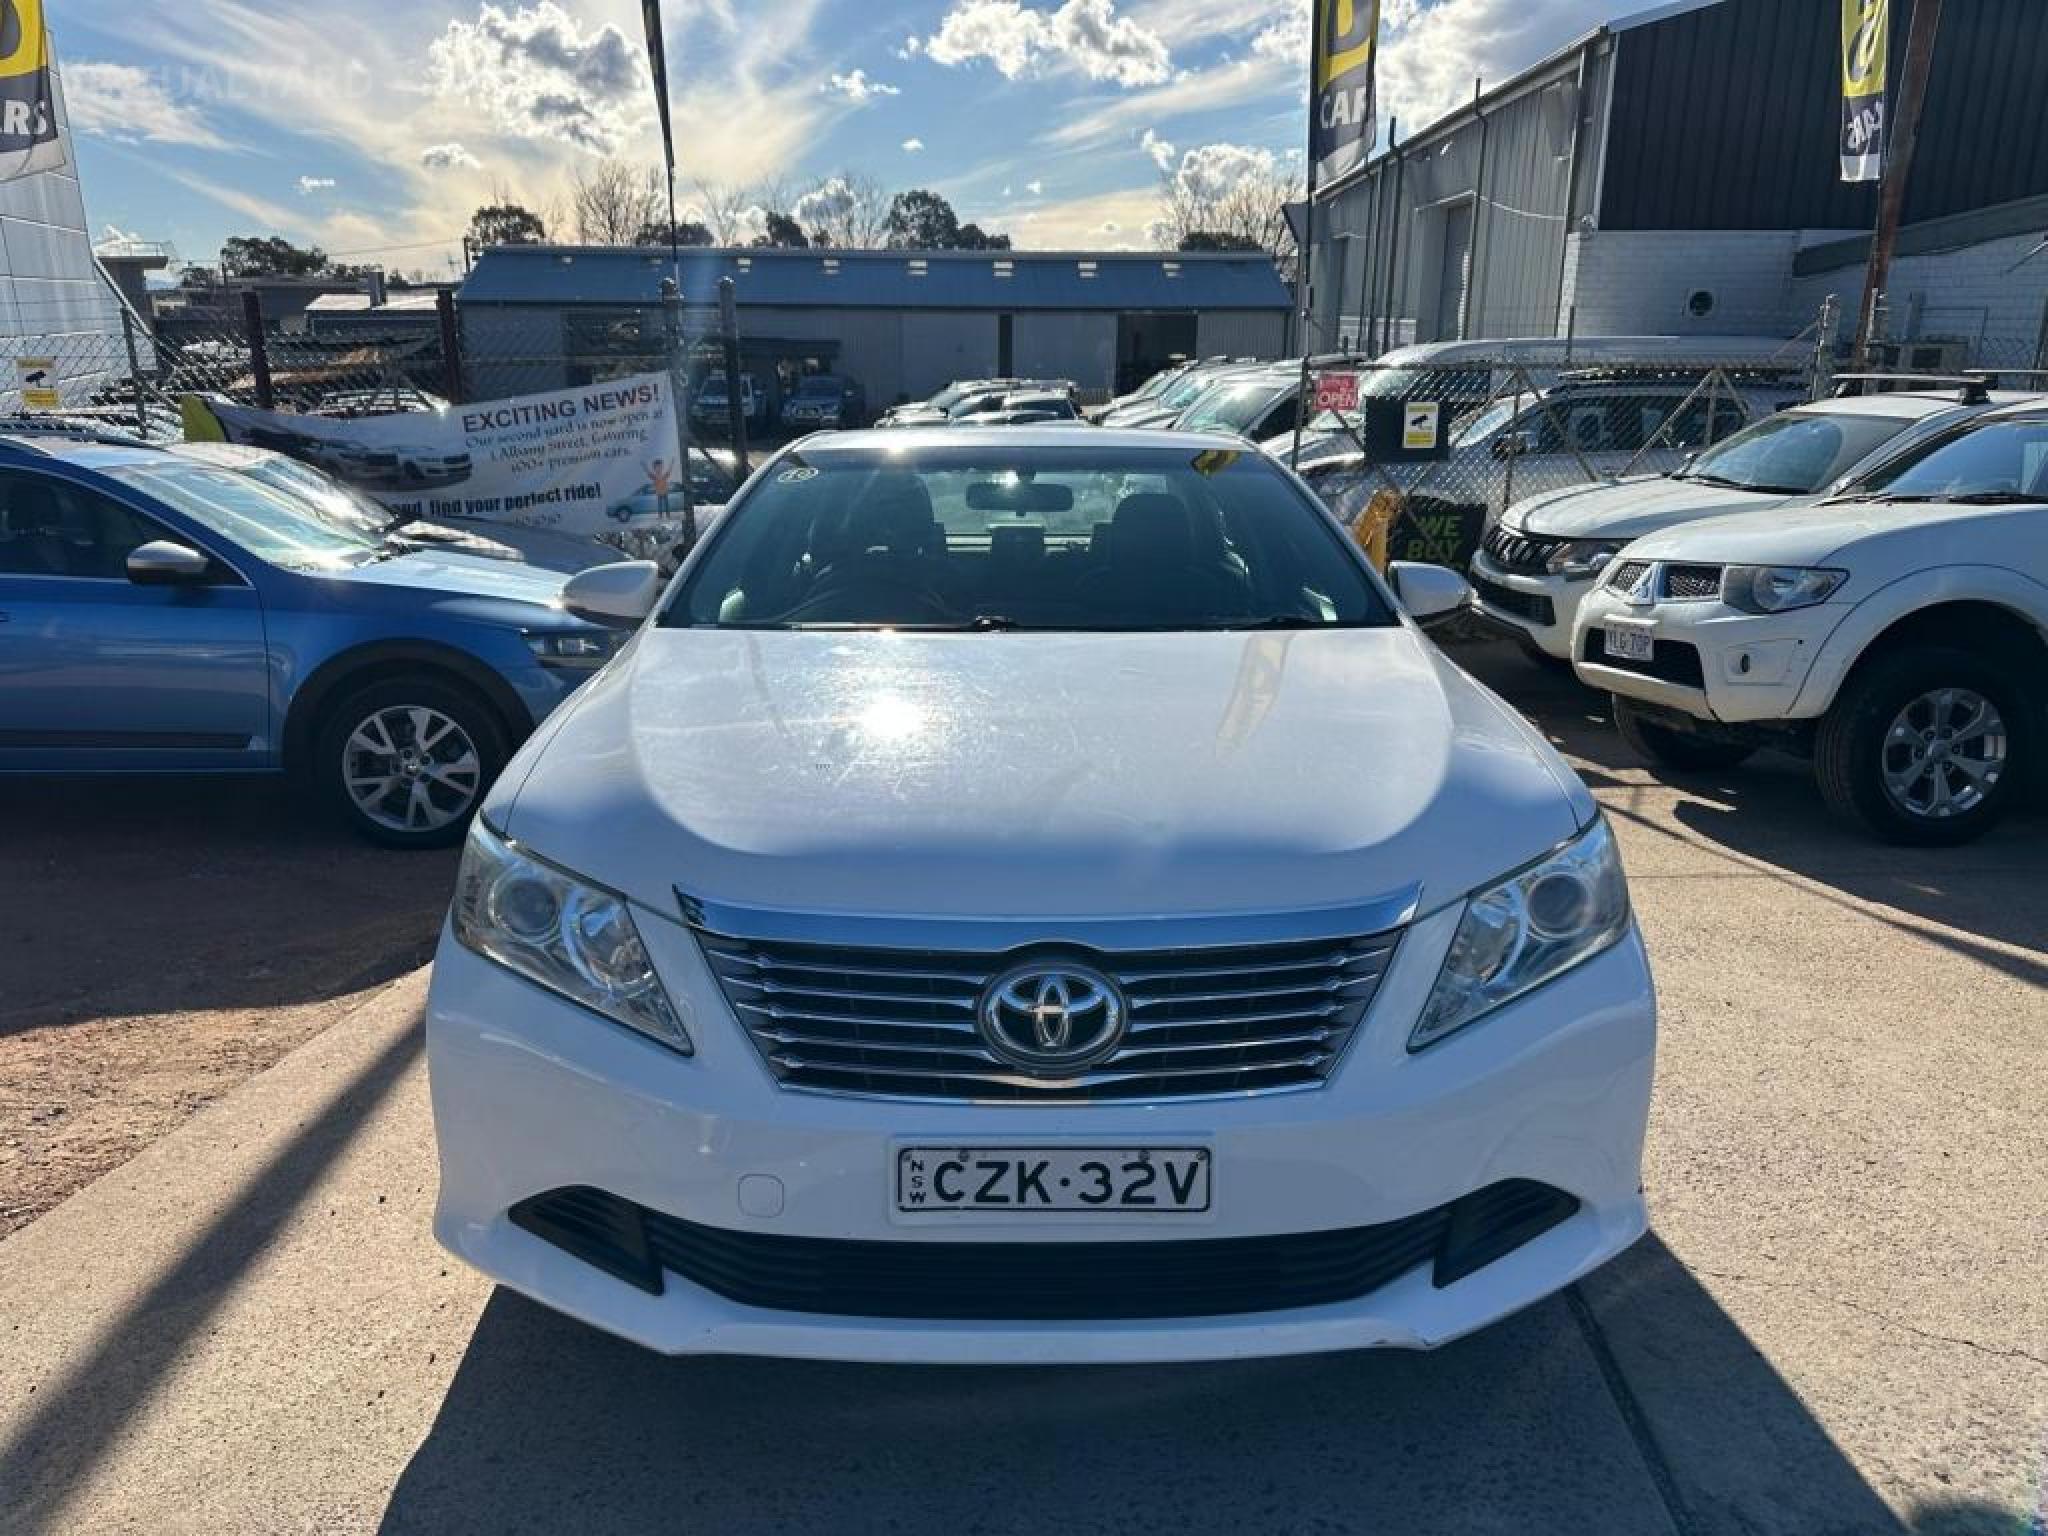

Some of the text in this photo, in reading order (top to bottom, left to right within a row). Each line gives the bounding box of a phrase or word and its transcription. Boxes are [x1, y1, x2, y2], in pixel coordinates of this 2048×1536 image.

[462, 383, 659, 433] EXCITING NEWS!
[1320, 391, 1359, 407] OPEN
[465, 434, 492, 449] Our
[497, 427, 541, 446] second
[543, 420, 575, 440] yard
[590, 417, 616, 430] now
[619, 410, 649, 427] open
[430, 498, 462, 515] find
[465, 496, 500, 514] your
[504, 487, 562, 511] perfect
[563, 481, 602, 501] ride!
[1416, 515, 1464, 537] WE
[1408, 539, 1463, 561] BUY
[909, 1159, 926, 1204] NSW
